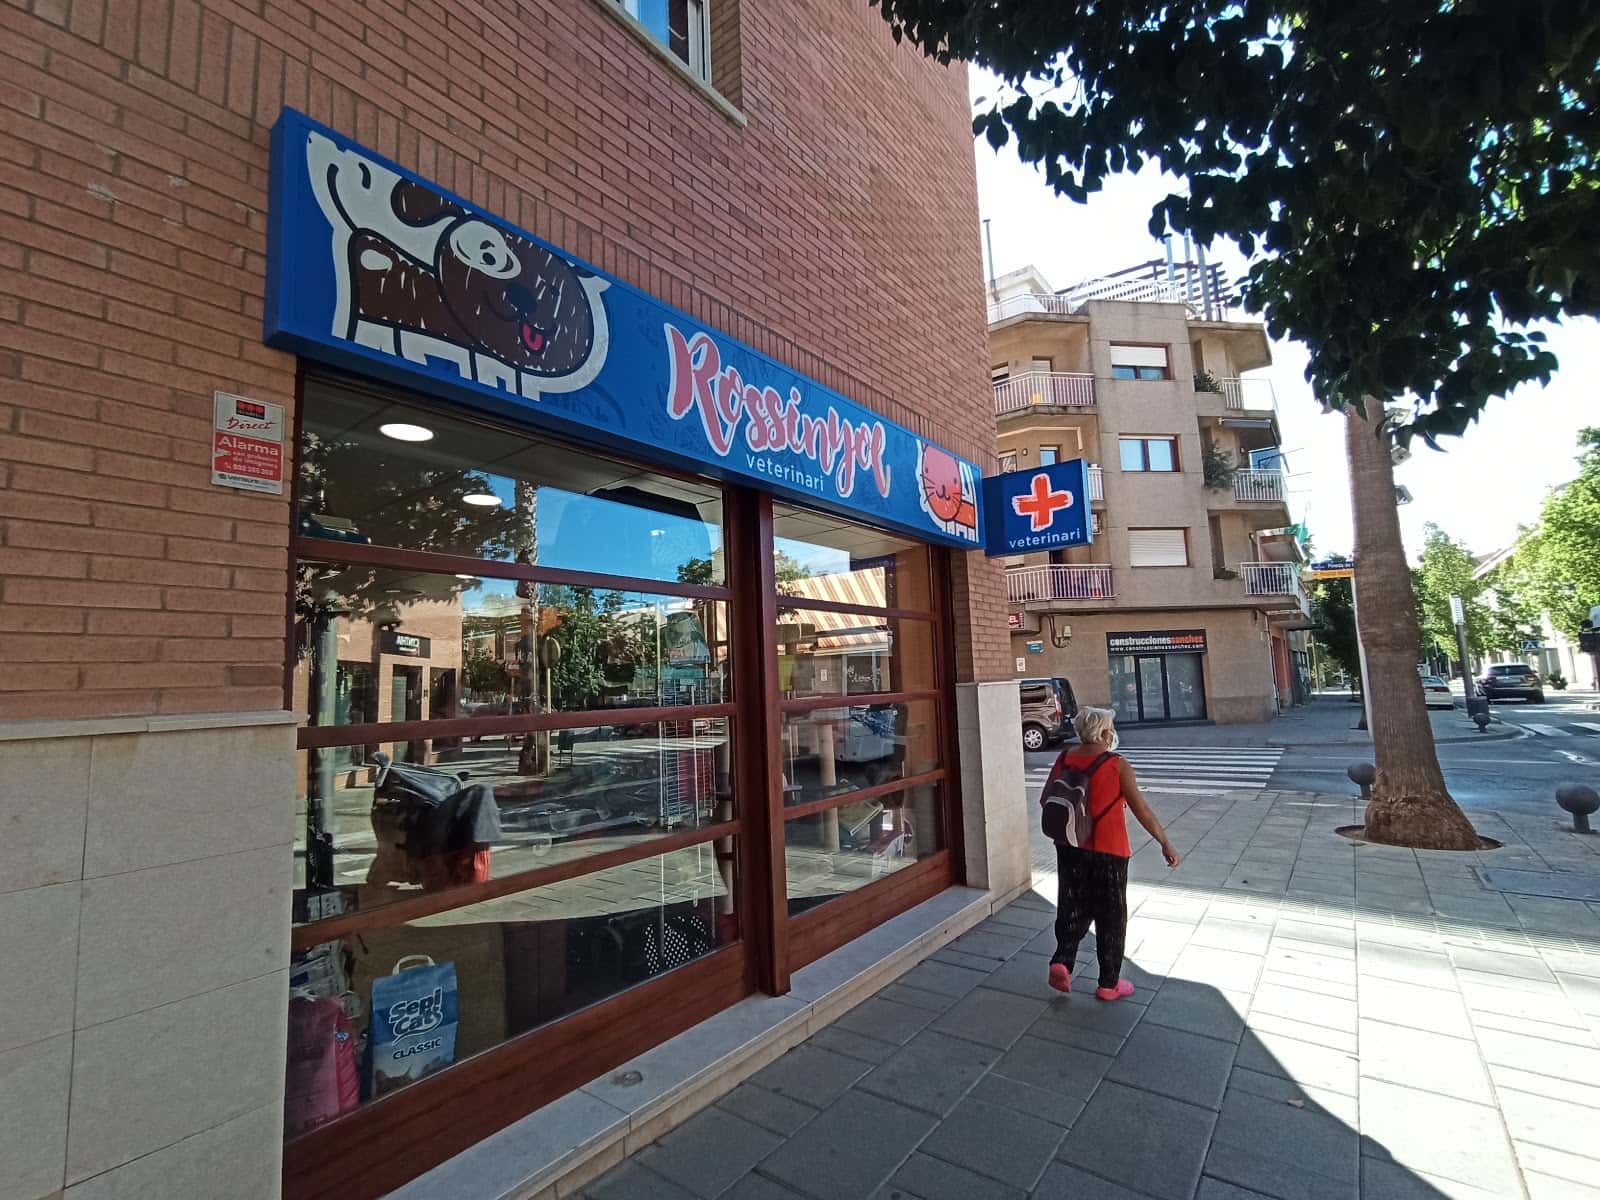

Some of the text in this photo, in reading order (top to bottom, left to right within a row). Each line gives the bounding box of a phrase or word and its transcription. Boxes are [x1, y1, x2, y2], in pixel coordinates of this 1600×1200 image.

[663, 323, 890, 498] Rossinyol
[218, 435, 279, 457] Alarma
[746, 453, 825, 492] veterinari
[1009, 527, 1081, 549] veterinari
[392, 1038, 441, 1060] CLASSIC
